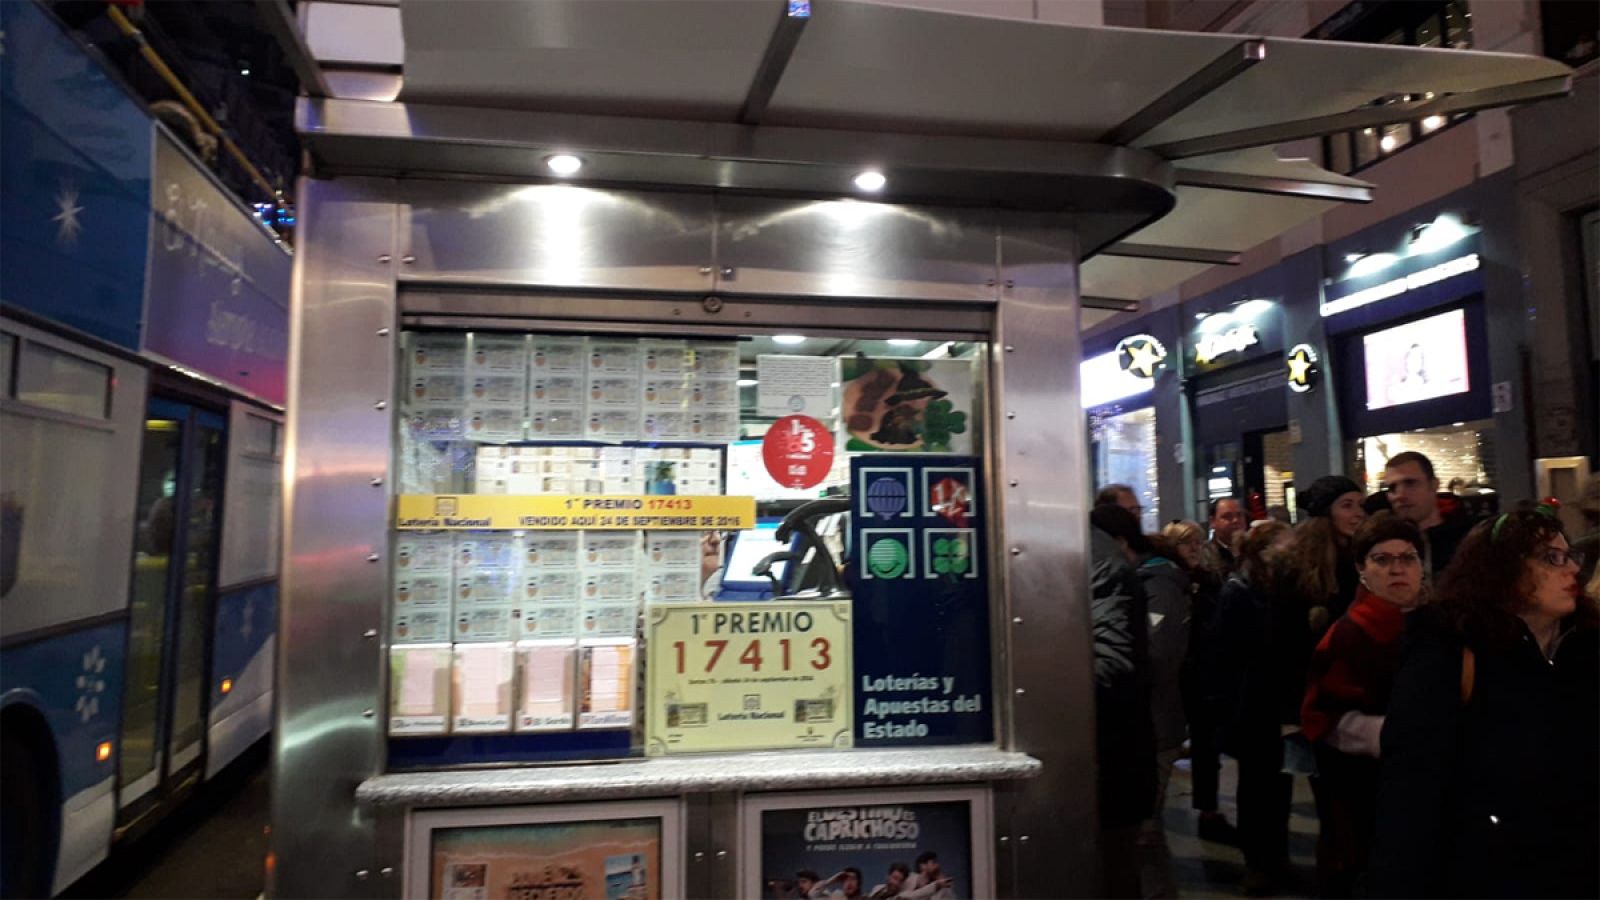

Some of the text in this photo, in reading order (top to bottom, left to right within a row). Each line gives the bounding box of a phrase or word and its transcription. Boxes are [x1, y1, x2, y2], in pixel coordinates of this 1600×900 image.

[584, 498, 642, 510] PREMIO
[648, 500, 693, 510] 17413
[445, 516, 491, 527] Nacional
[519, 516, 567, 526] VENDIDO
[616, 516, 629, 526] DE
[634, 516, 696, 526] SEPTIEMBRE
[701, 516, 713, 526] DE
[714, 611, 813, 634] PREMIO
[862, 673, 956, 695] Loterías y
[863, 694, 981, 720] Apuestas del
[863, 720, 929, 740] Estado
[804, 820, 919, 841] CAPRICHOSO
